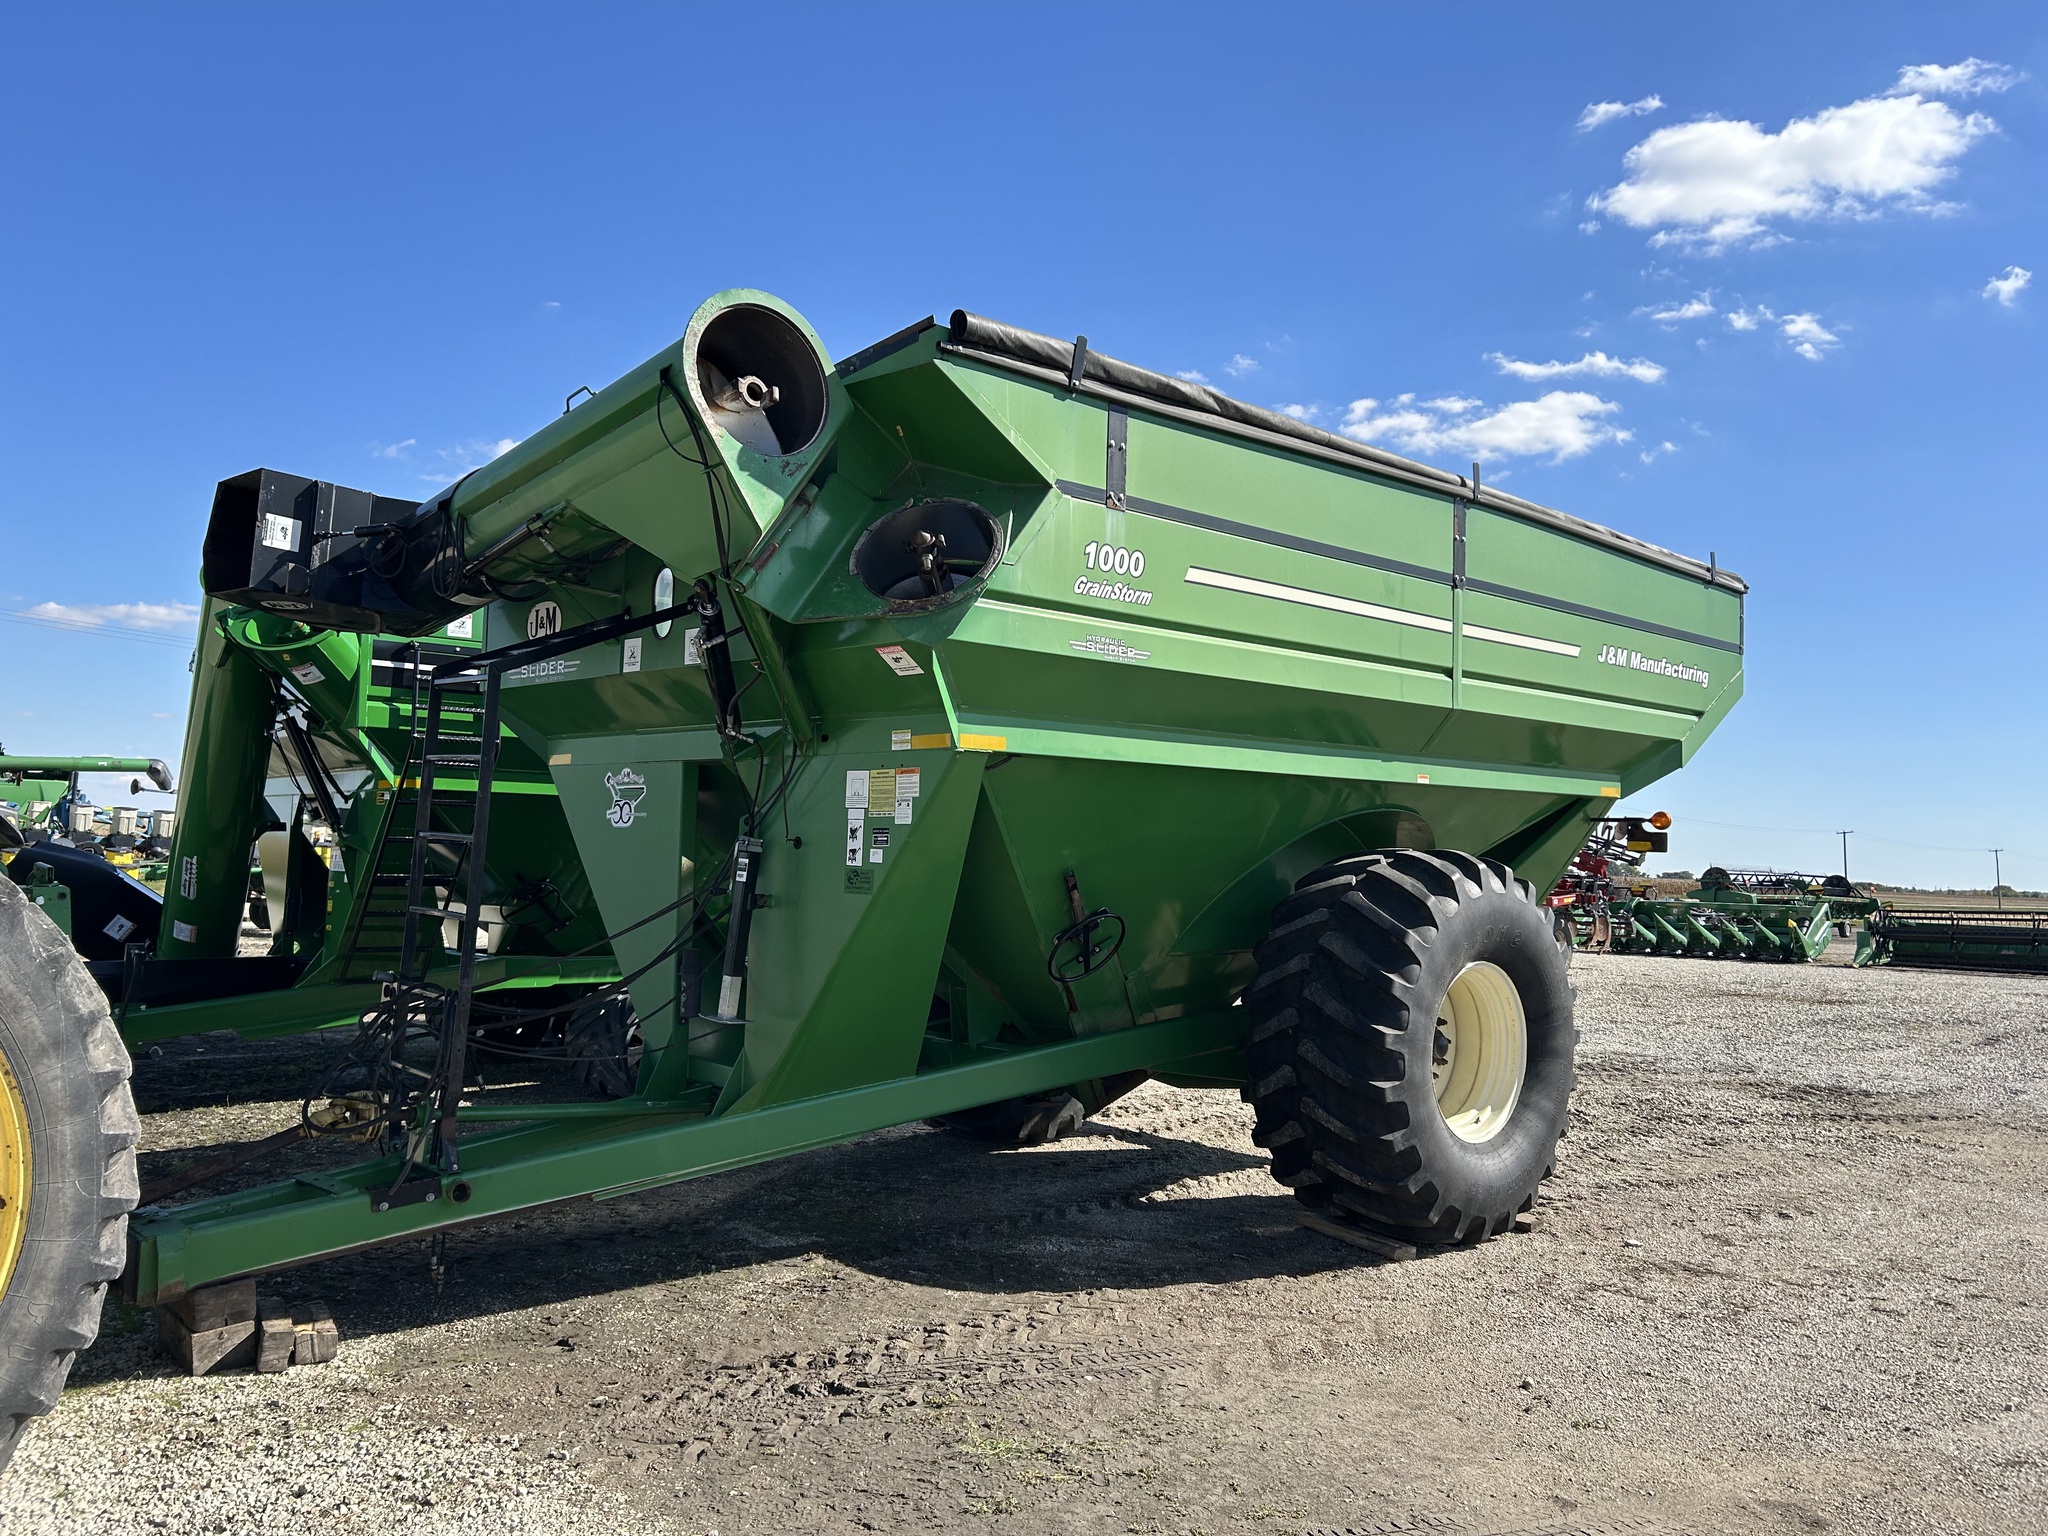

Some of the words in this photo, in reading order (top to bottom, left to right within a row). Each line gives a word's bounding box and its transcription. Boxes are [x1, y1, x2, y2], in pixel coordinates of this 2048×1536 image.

[1084, 540, 1146, 578] 1000
[1073, 575, 1153, 606] GrainStorm
[530, 606, 557, 638] J&M
[1086, 634, 1126, 645] HYDRAULIC
[1086, 641, 1136, 658] SLIDER
[521, 660, 565, 678] SLIDER
[1597, 643, 1628, 667] J&M
[1629, 650, 1709, 689] Manufacturing
[612, 800, 632, 824] 50
